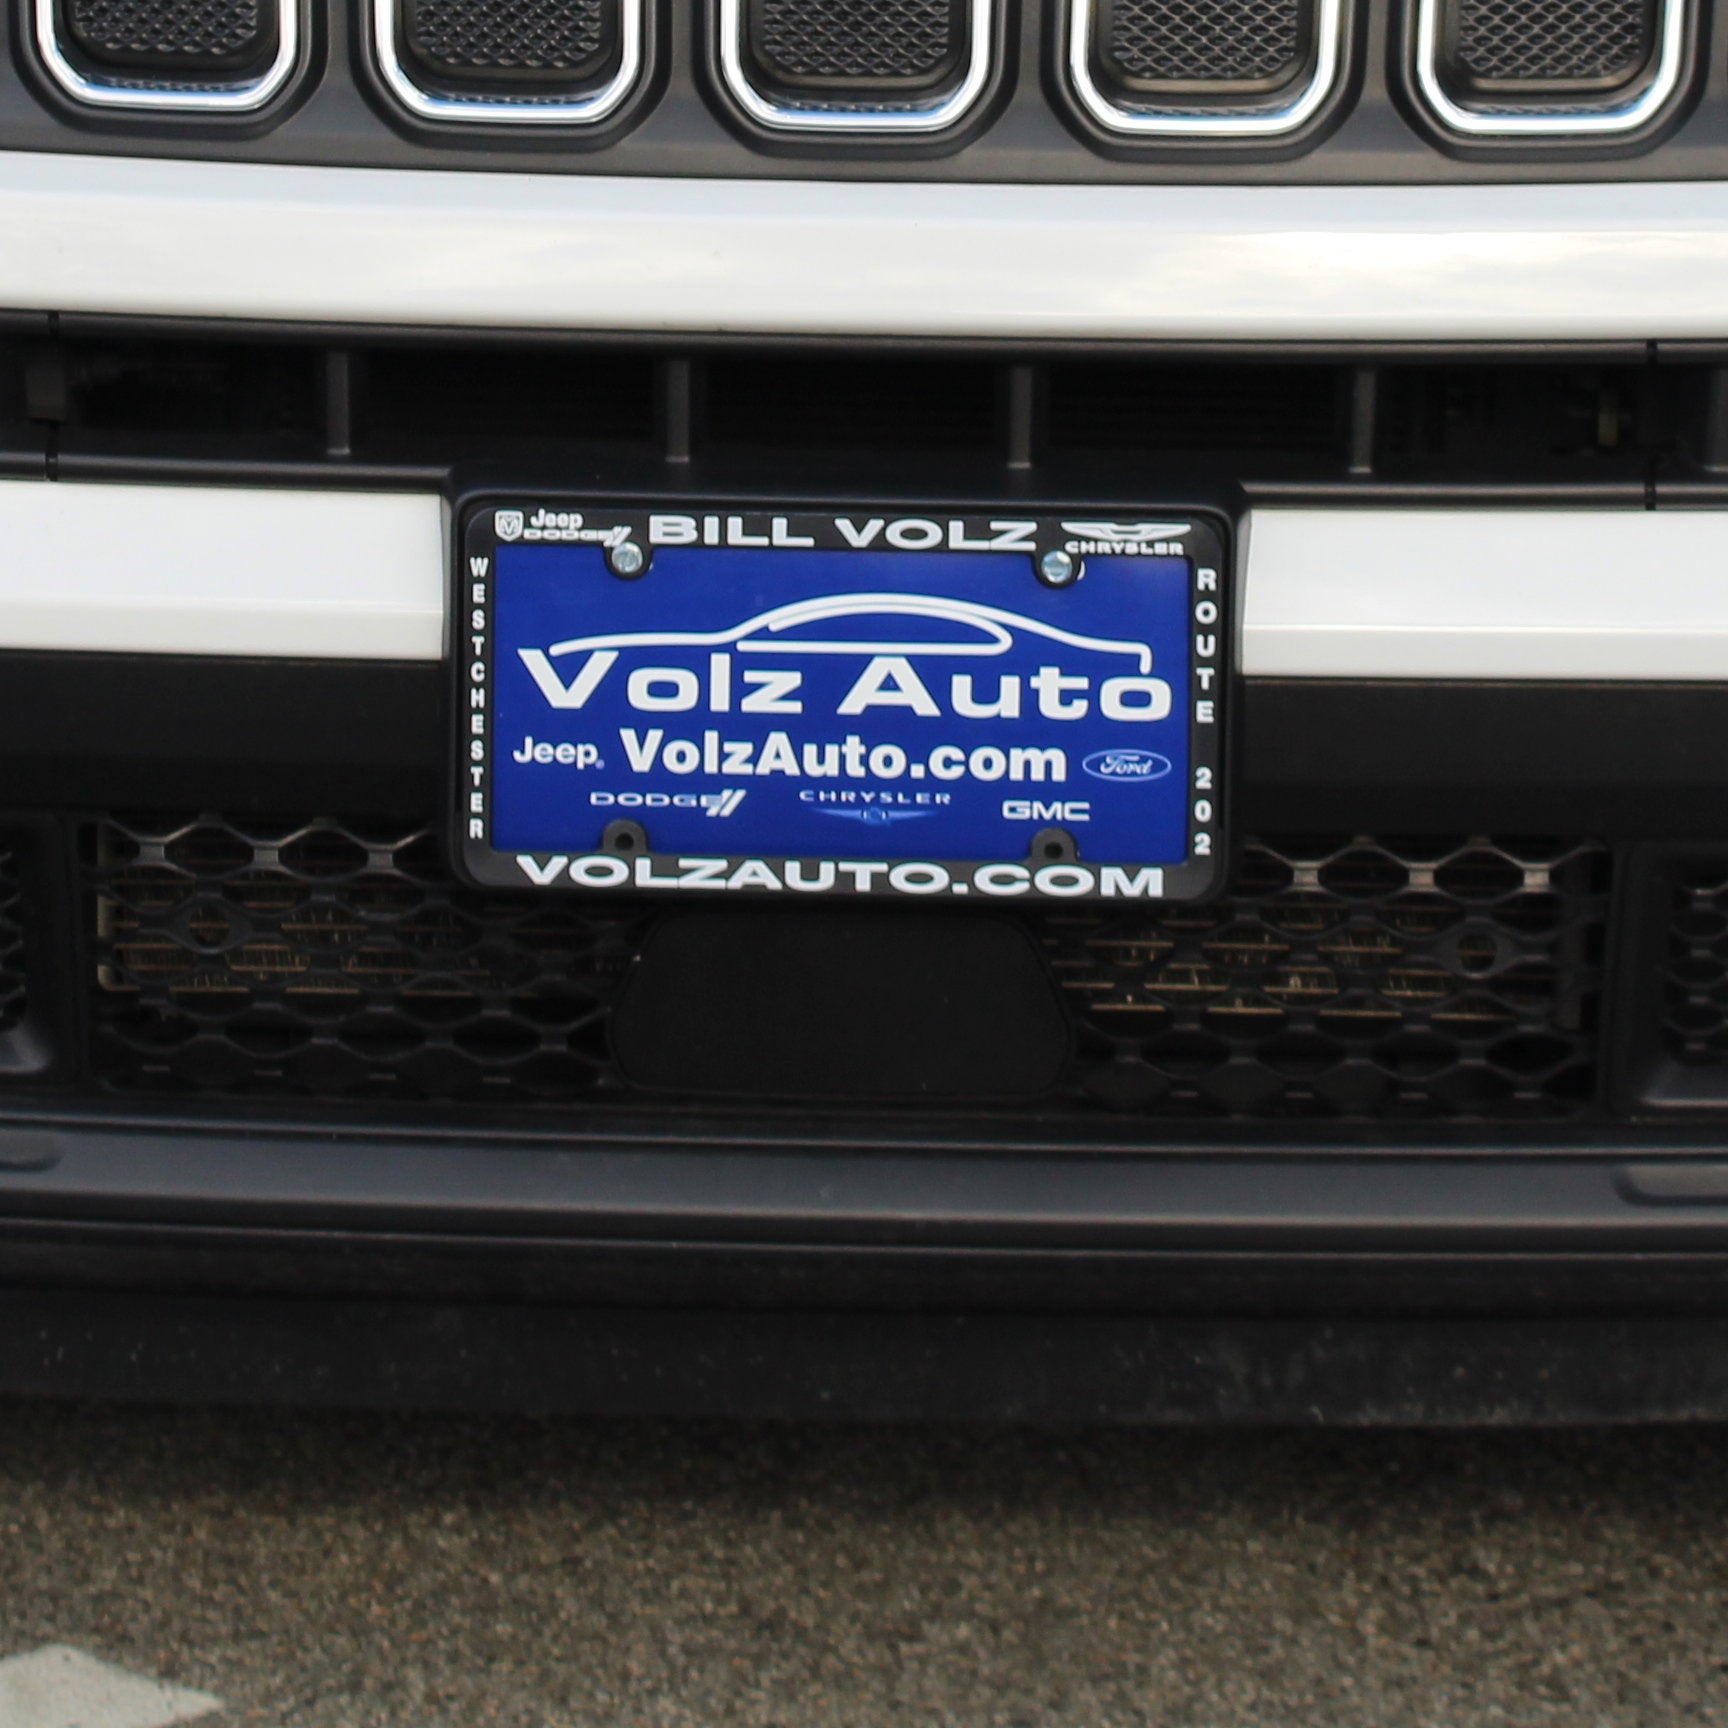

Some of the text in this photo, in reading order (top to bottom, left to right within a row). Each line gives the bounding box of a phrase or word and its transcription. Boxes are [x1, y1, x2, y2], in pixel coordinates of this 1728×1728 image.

[529, 508, 584, 530] Jeep
[649, 514, 1038, 551] BILL VOLZ
[1064, 540, 1184, 556] CHRYSLER
[469, 556, 489, 839] WESTCHESTER
[517, 647, 1173, 722] Volz Auto
[1193, 567, 1219, 856] ROUTE 202
[512, 735, 598, 770] Jeep
[618, 727, 1068, 783] VolzAuto.com
[1099, 755, 1153, 775] Ford
[798, 789, 952, 806] CHRYSLER
[1001, 800, 1091, 822] GMC
[515, 854, 1165, 898] VOLZAUTO.COM
